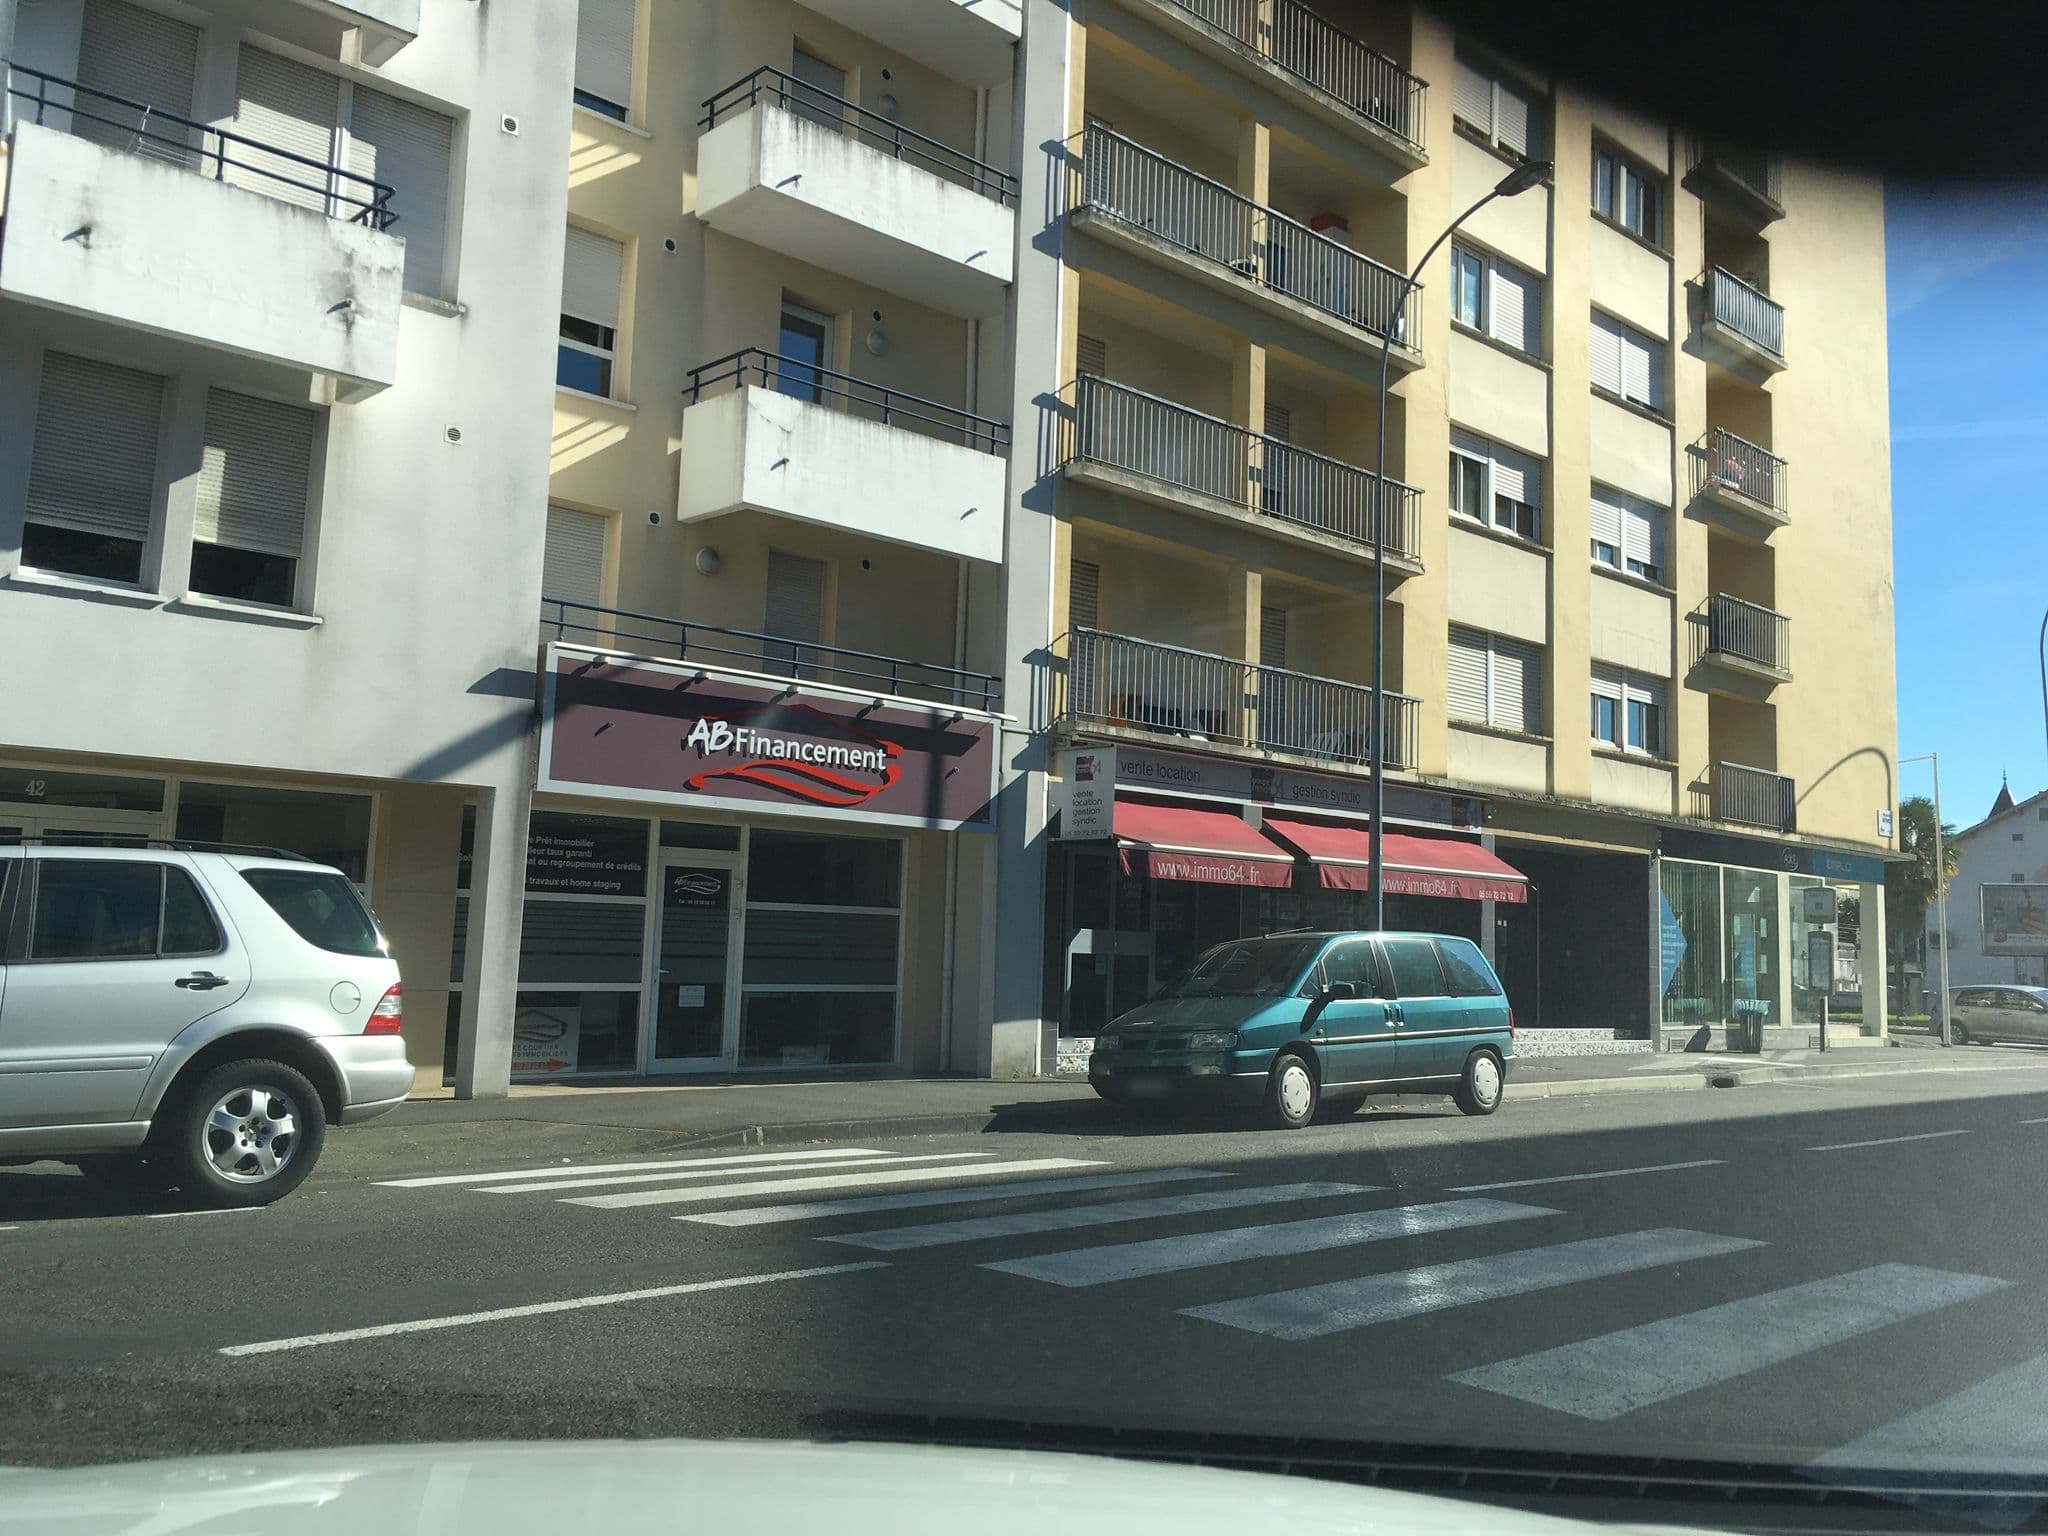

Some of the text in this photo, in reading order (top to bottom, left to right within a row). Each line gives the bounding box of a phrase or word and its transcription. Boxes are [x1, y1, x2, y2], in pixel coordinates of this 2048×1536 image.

[687, 718, 887, 770] AB Financement
[1120, 760, 1201, 783] vente location
[25, 779, 45, 796] 42
[1072, 790, 1094, 798] vente
[1292, 783, 1361, 804] gestion syndic
[1072, 799, 1103, 807] location
[1072, 808, 1101, 818] gestion
[1072, 817, 1097, 827] syndic
[553, 837, 595, 847] immobilier
[546, 847, 564, 856] taux
[565, 849, 593, 858] garanti
[550, 860, 604, 869] regroupement
[1157, 861, 1260, 883] www.immo64.fr
[529, 877, 621, 890] travaux et home staging
